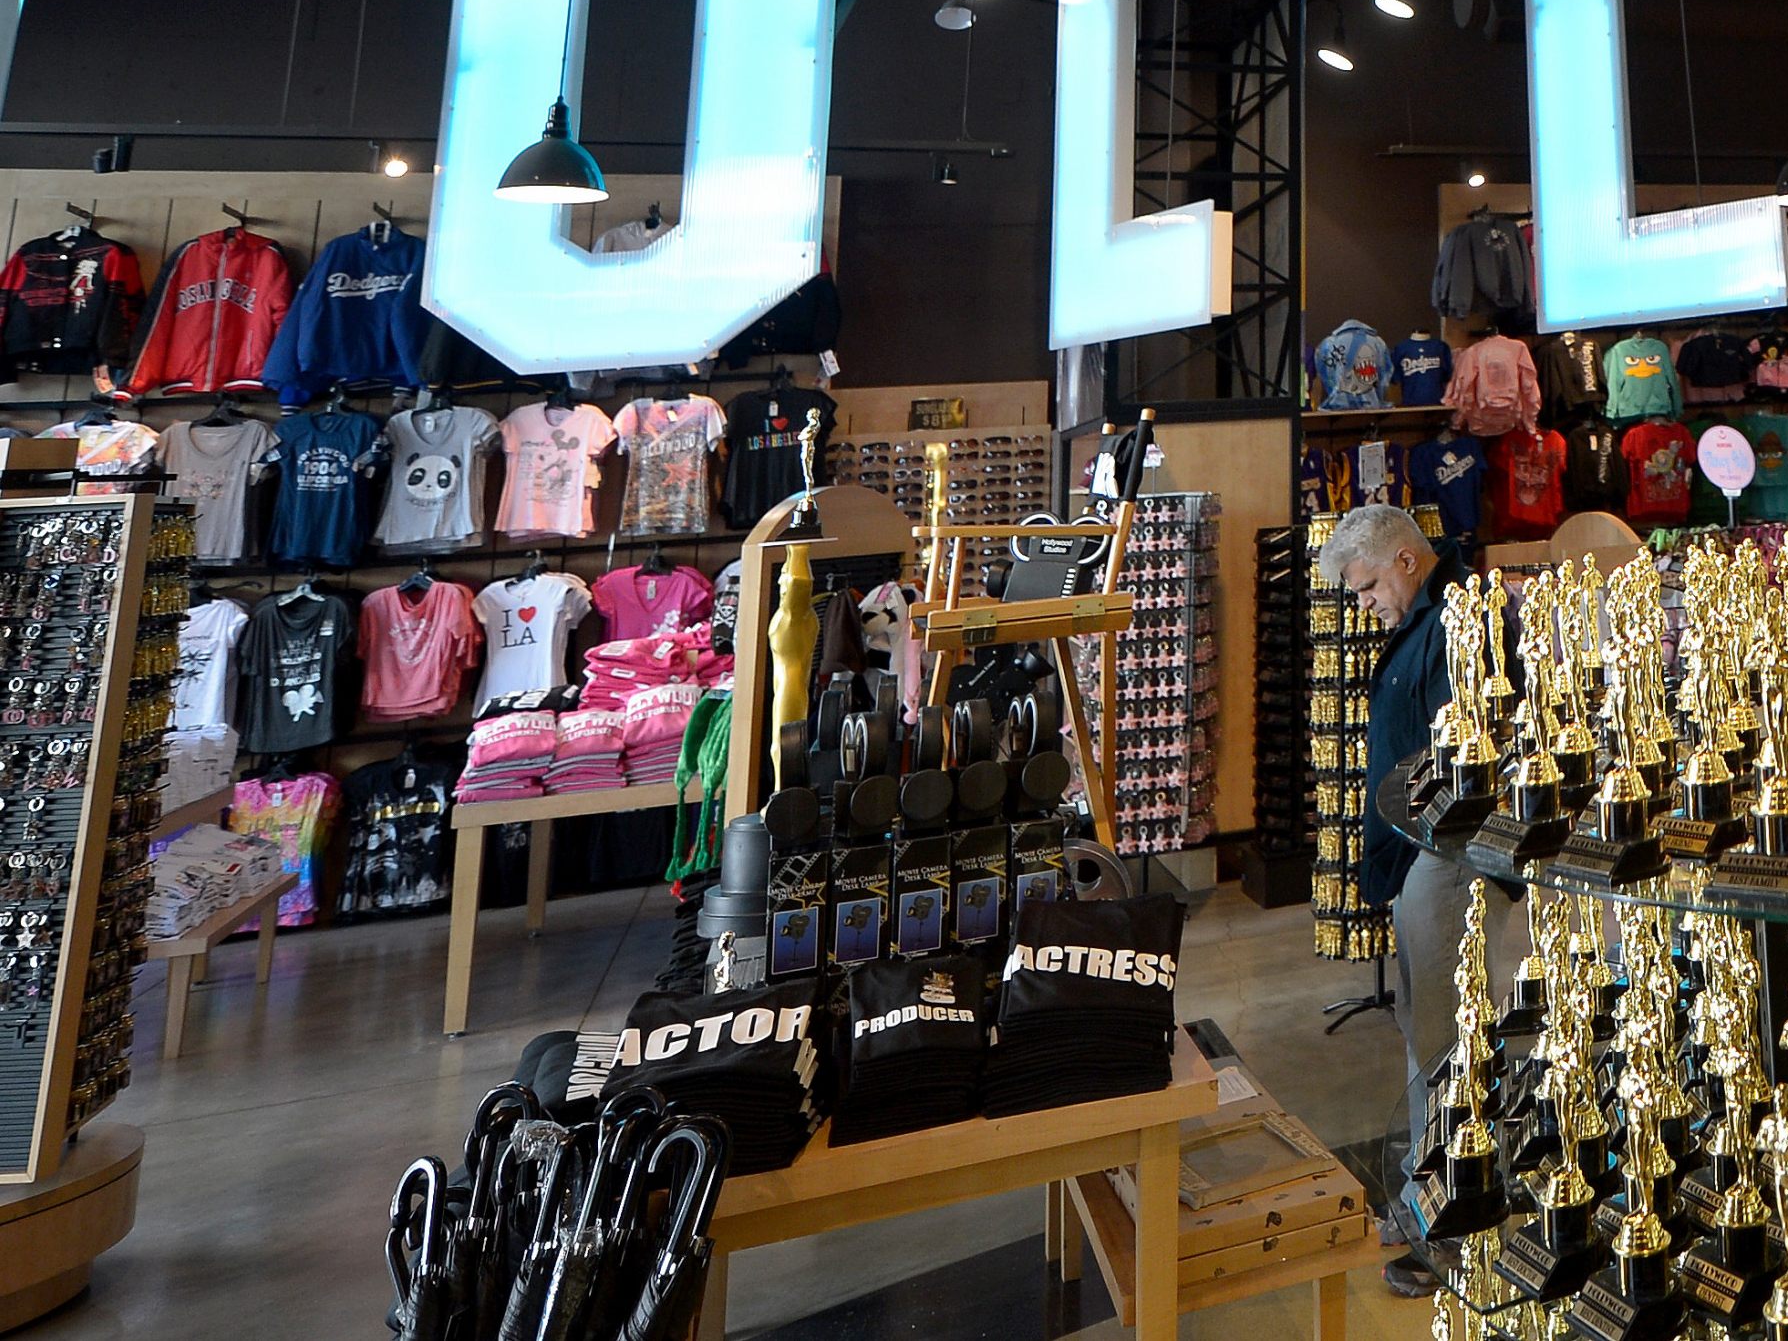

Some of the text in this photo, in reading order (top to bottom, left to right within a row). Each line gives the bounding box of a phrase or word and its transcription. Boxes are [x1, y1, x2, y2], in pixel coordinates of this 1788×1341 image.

[765, 431, 800, 449] ANGELE
[303, 461, 338, 475] 1904
[1041, 538, 1073, 547] Hollywood
[502, 609, 512, 628] I
[501, 626, 538, 649] LA
[1728, 874, 1781, 888] BEST FAMILY
[1002, 943, 1177, 992] ACTRESS
[854, 1003, 976, 1039] PRODUCER
[610, 1004, 813, 1069] ACTOR
[1690, 1259, 1739, 1289] HOLLYWOOD
[1588, 1283, 1629, 1318] HOLLYWOOD
[1699, 1285, 1726, 1306] DENTIST
